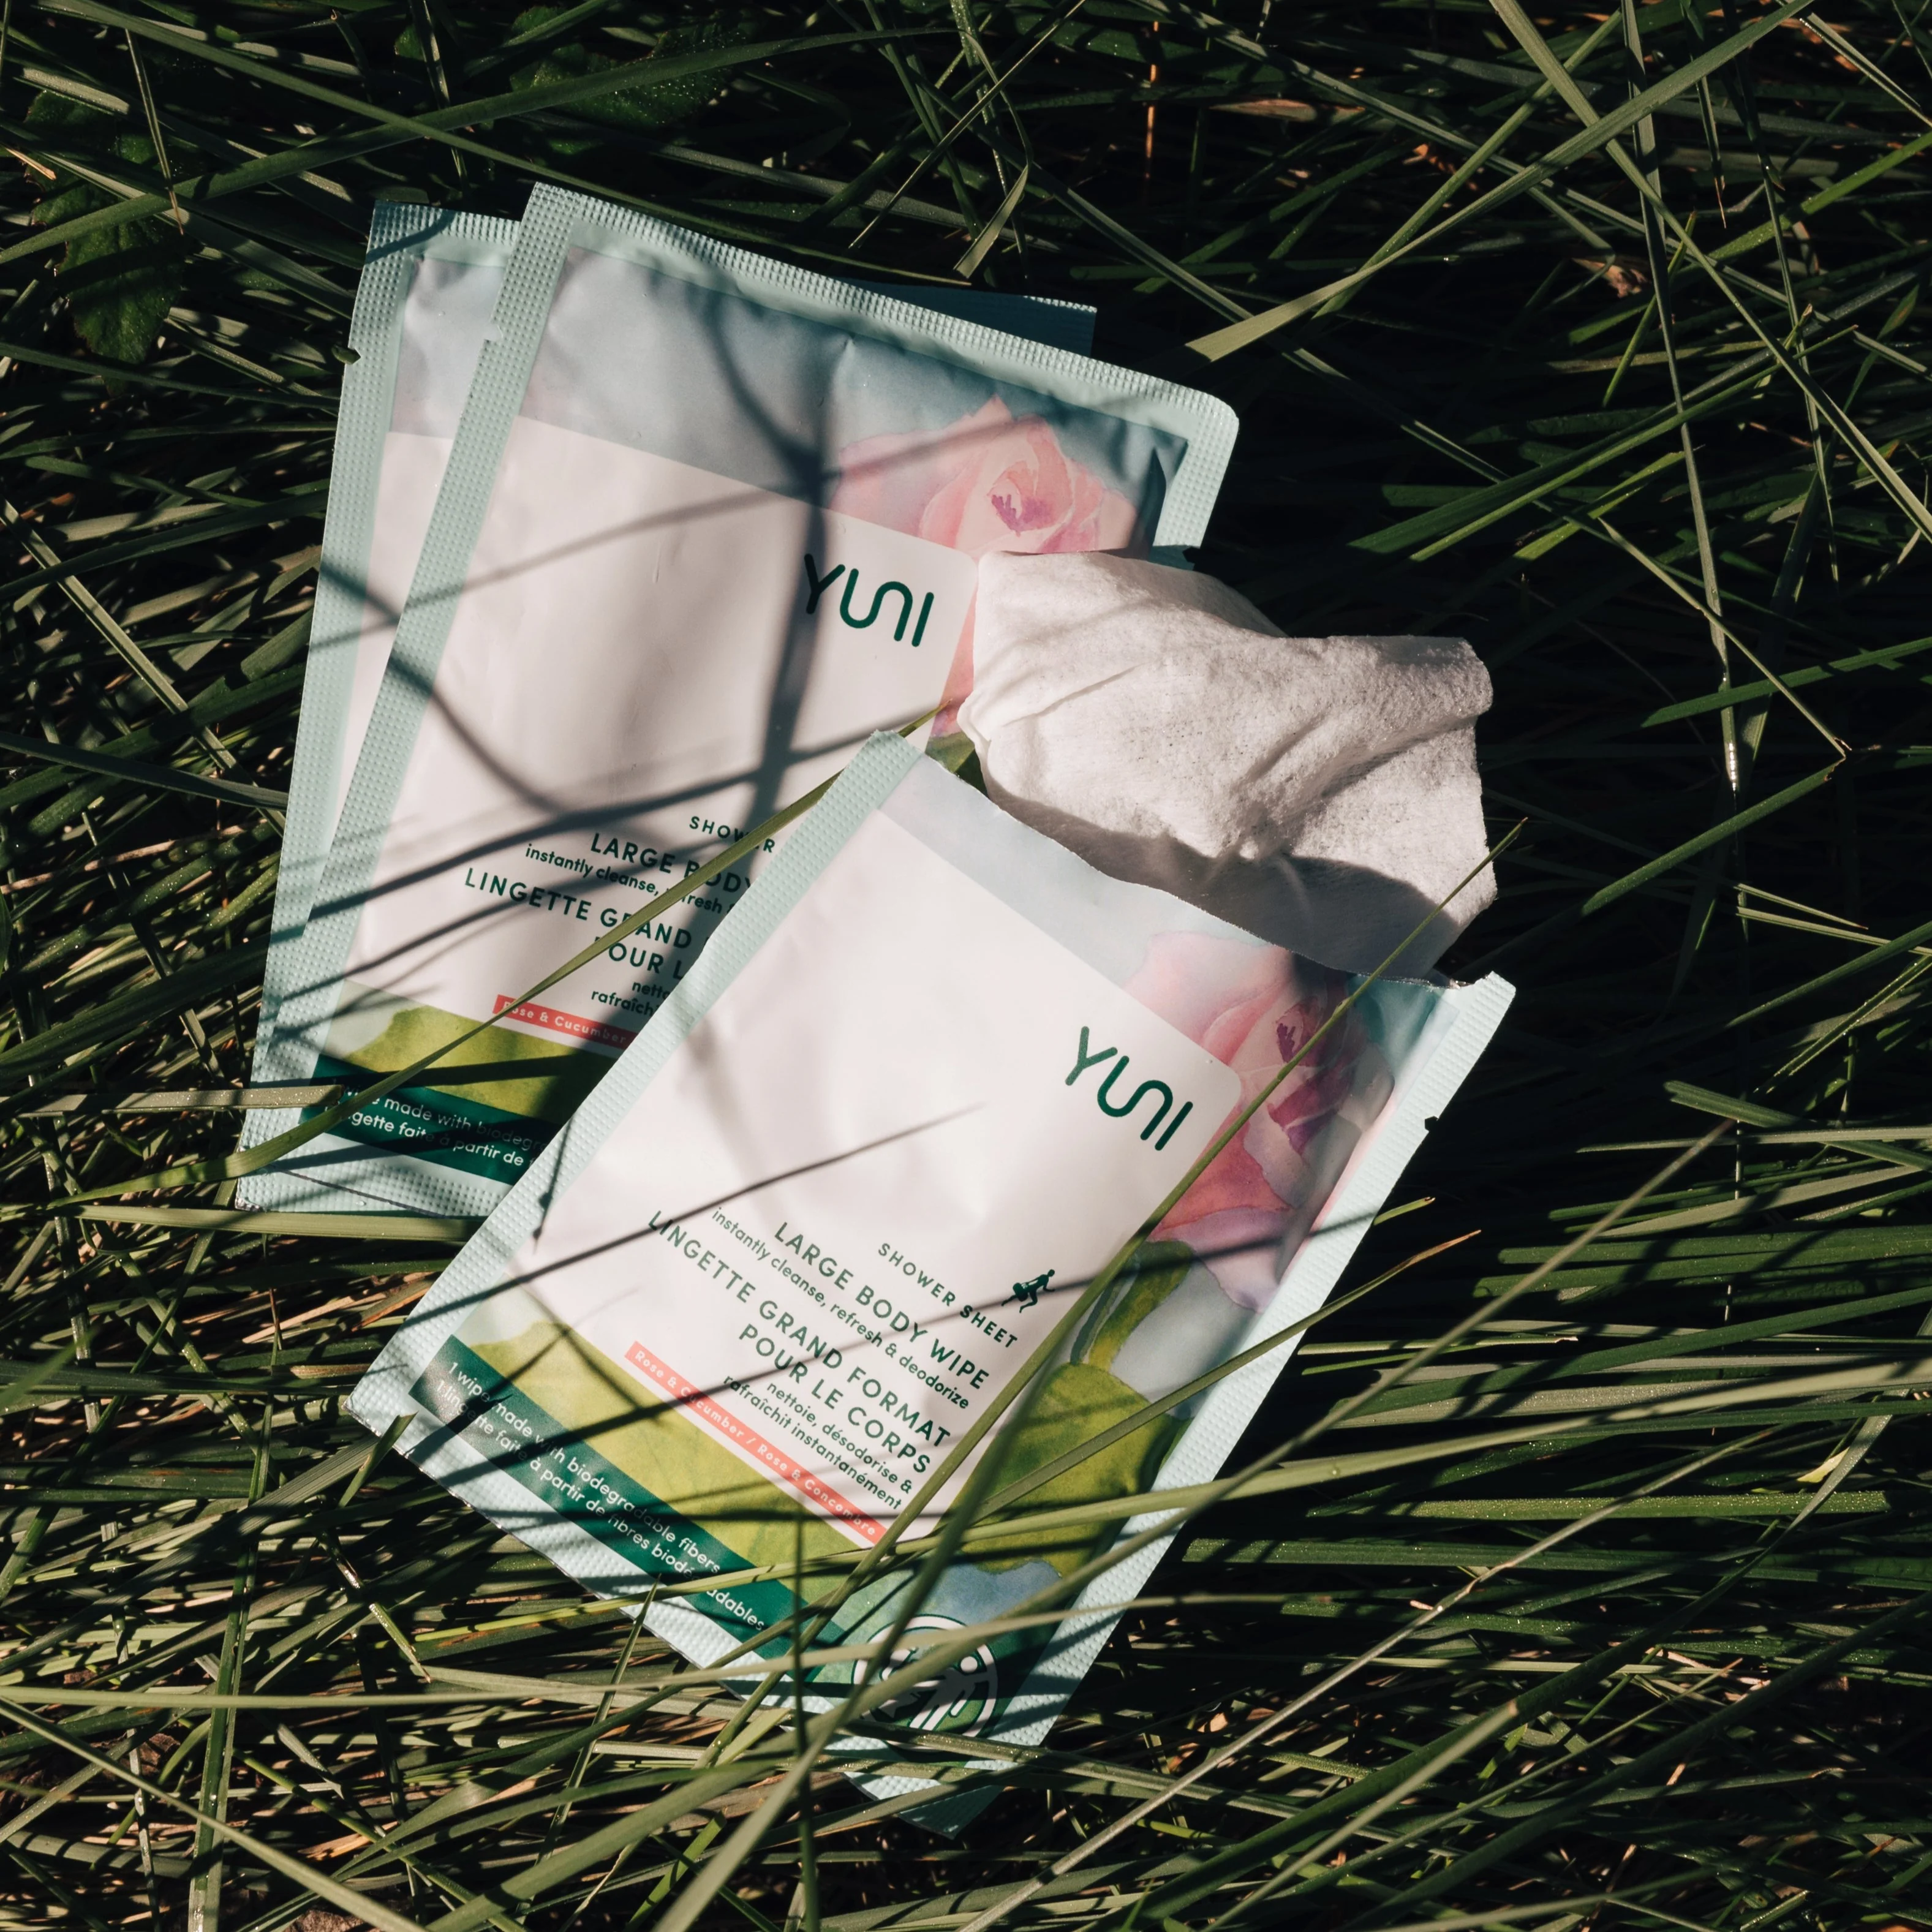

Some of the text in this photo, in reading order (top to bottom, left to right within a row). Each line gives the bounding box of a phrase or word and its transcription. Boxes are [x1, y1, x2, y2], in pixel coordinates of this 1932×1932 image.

[804, 554, 934, 647] YUNI
[525, 843, 593, 878] instantly
[596, 864, 659, 896] cleanse,
[591, 833, 676, 874] LARGE
[689, 816, 775, 853] SHOWR
[464, 867, 592, 921] LINGETTE
[594, 937, 663, 974] OUR
[540, 1011, 548, 1023] &
[554, 1016, 627, 1043] Cucumber
[384, 1098, 432, 1120] made
[438, 1114, 471, 1131] with
[1065, 1026, 1193, 1151] YUNI
[453, 1140, 501, 1159] partir
[503, 1151, 524, 1166] de
[648, 1210, 951, 1448] LINGETTE GRAND FORMAT
[712, 1207, 970, 1409] instantly cleanse, refresh & deodorize
[774, 1222, 990, 1390] LARGE BODY WIPE
[878, 1242, 1017, 1348] SHOWER SHEET
[635, 1348, 664, 1379] Rose
[668, 1375, 677, 1389] &
[680, 1385, 745, 1439] Cucumber
[757, 1443, 788, 1472] Rose
[791, 1469, 801, 1481] &
[804, 1479, 875, 1536] Concombre
[723, 1373, 902, 1509] rafraîchit instantanément
[739, 1324, 932, 1474] POUR LE CORPS
[767, 1381, 912, 1494] nettoie, désodorise &
[436, 1379, 445, 1392] 1
[443, 1385, 494, 1434] lingette
[496, 1430, 528, 1460] faite
[530, 1456, 541, 1472] à
[540, 1470, 585, 1508] partir
[586, 1496, 605, 1517] de
[608, 1511, 649, 1550] fibres
[448, 1362, 720, 1574] 1 wipe made with biodegradable fibers
